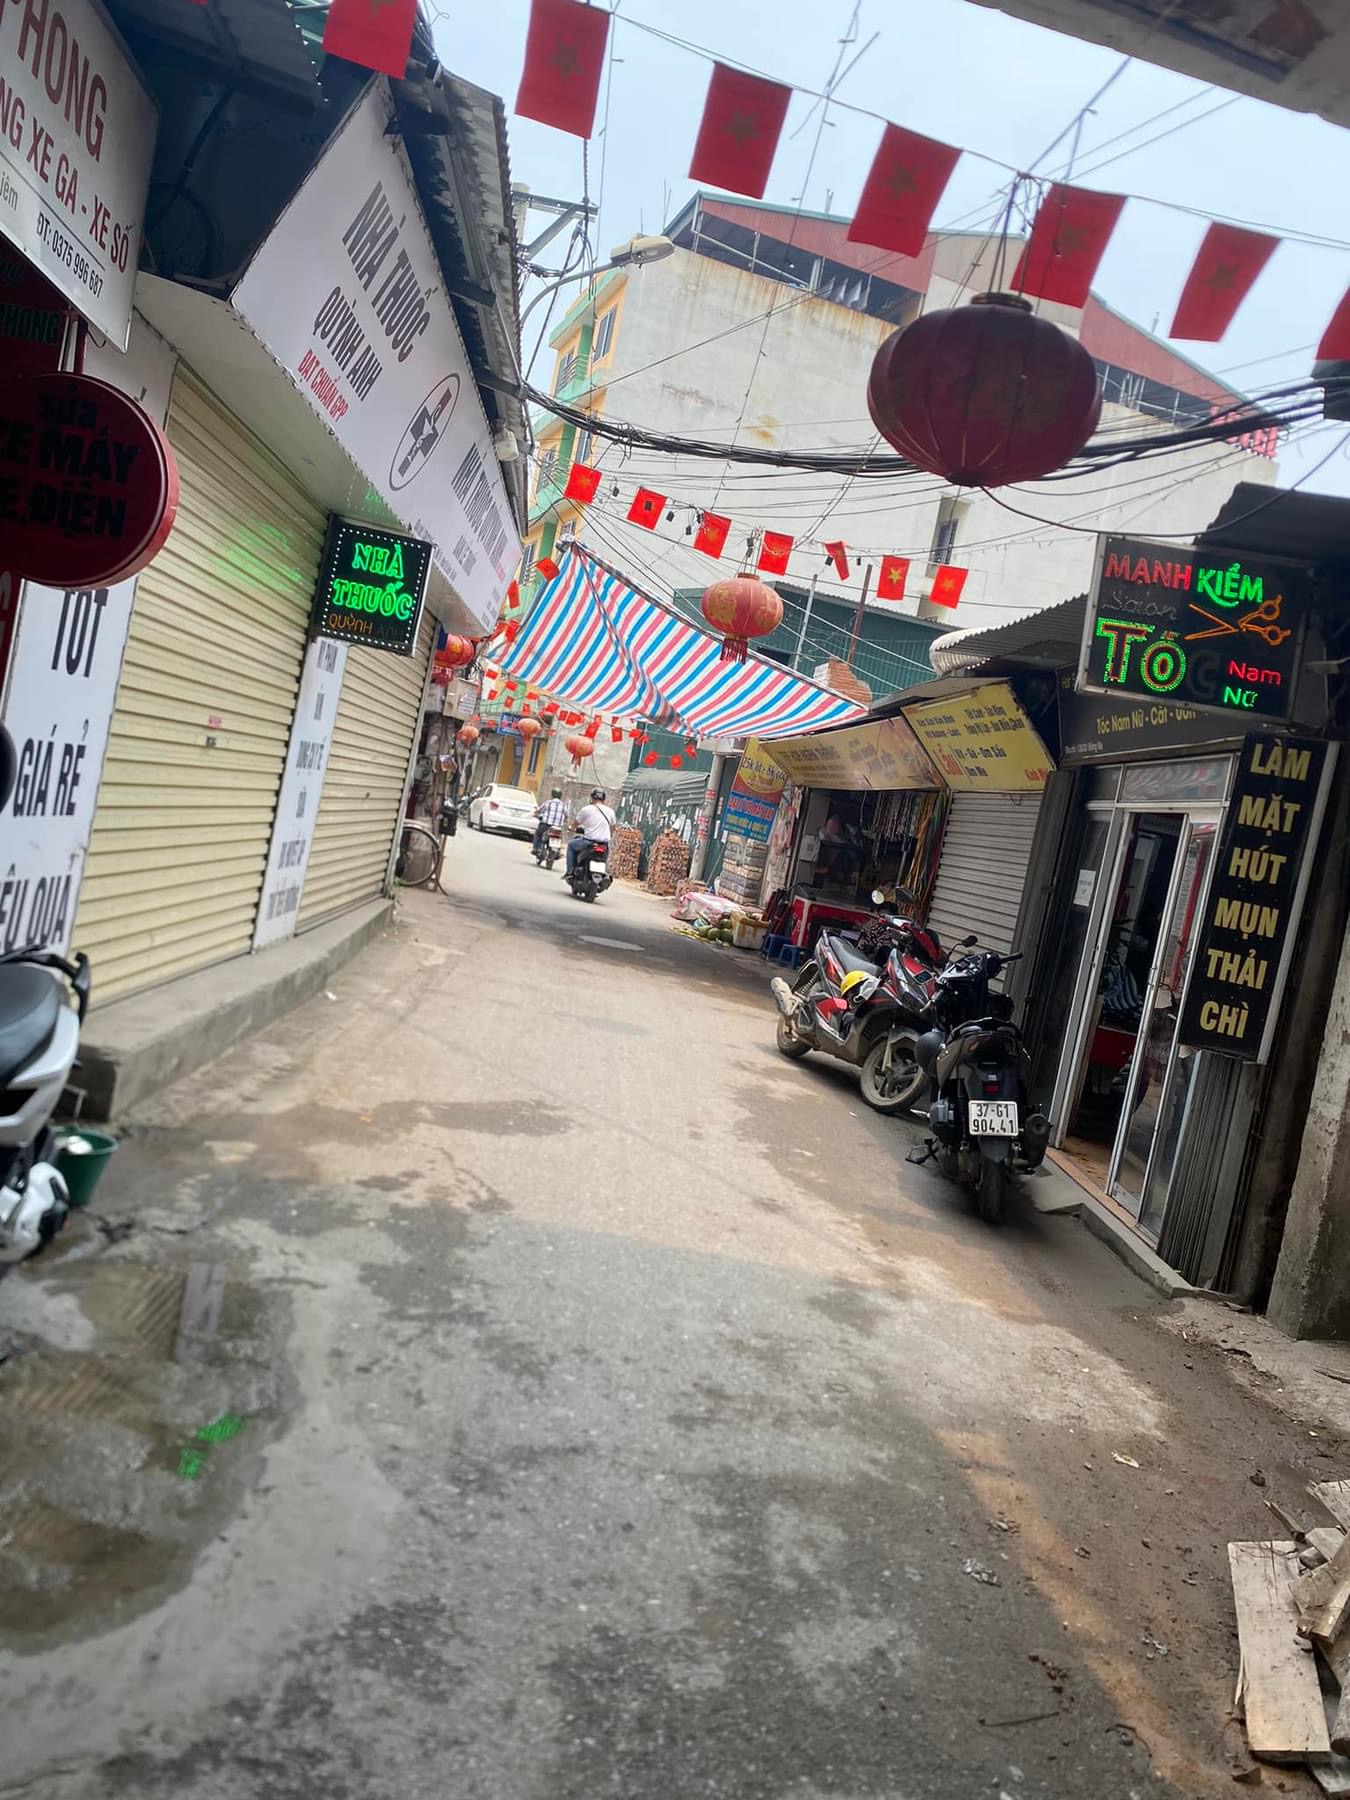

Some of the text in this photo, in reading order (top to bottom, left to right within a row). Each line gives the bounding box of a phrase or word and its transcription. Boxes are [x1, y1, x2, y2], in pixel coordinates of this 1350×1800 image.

[26, 116, 55, 183] XE
[55, 152, 78, 215] GA
[89, 194, 111, 251] XE
[111, 223, 135, 273] SỐ
[36, 211, 104, 298] ĐT: 0375 996 687
[342, 181, 438, 363] NHÀ THUỐC
[312, 286, 384, 402] QUỲNH ANH
[39, 425, 140, 484] MÁY
[352, 542, 404, 579] NHÀ
[1104, 552, 1264, 608] MẠNH KIỂM
[332, 578, 413, 620] THUỐC
[328, 613, 374, 635] QUỲNH
[1227, 660, 1282, 686] Nam
[1097, 716, 1111, 735] Tóc
[1111, 714, 1131, 733] Nam
[1132, 708, 1145, 729] Nữ
[1150, 705, 1168, 727] Cắt
[13, 718, 89, 817] GIÁ RẺ
[1250, 739, 1313, 782] LÀM
[1239, 795, 1301, 838] MẶT
[1229, 844, 1287, 886] HÚT
[1214, 896, 1281, 941] MỤN
[1206, 949, 1269, 990] THẢI
[1200, 999, 1249, 1040] CHÌ
[972, 1118, 1014, 1134] 904.41
[976, 1103, 1009, 1118] 37-G1
